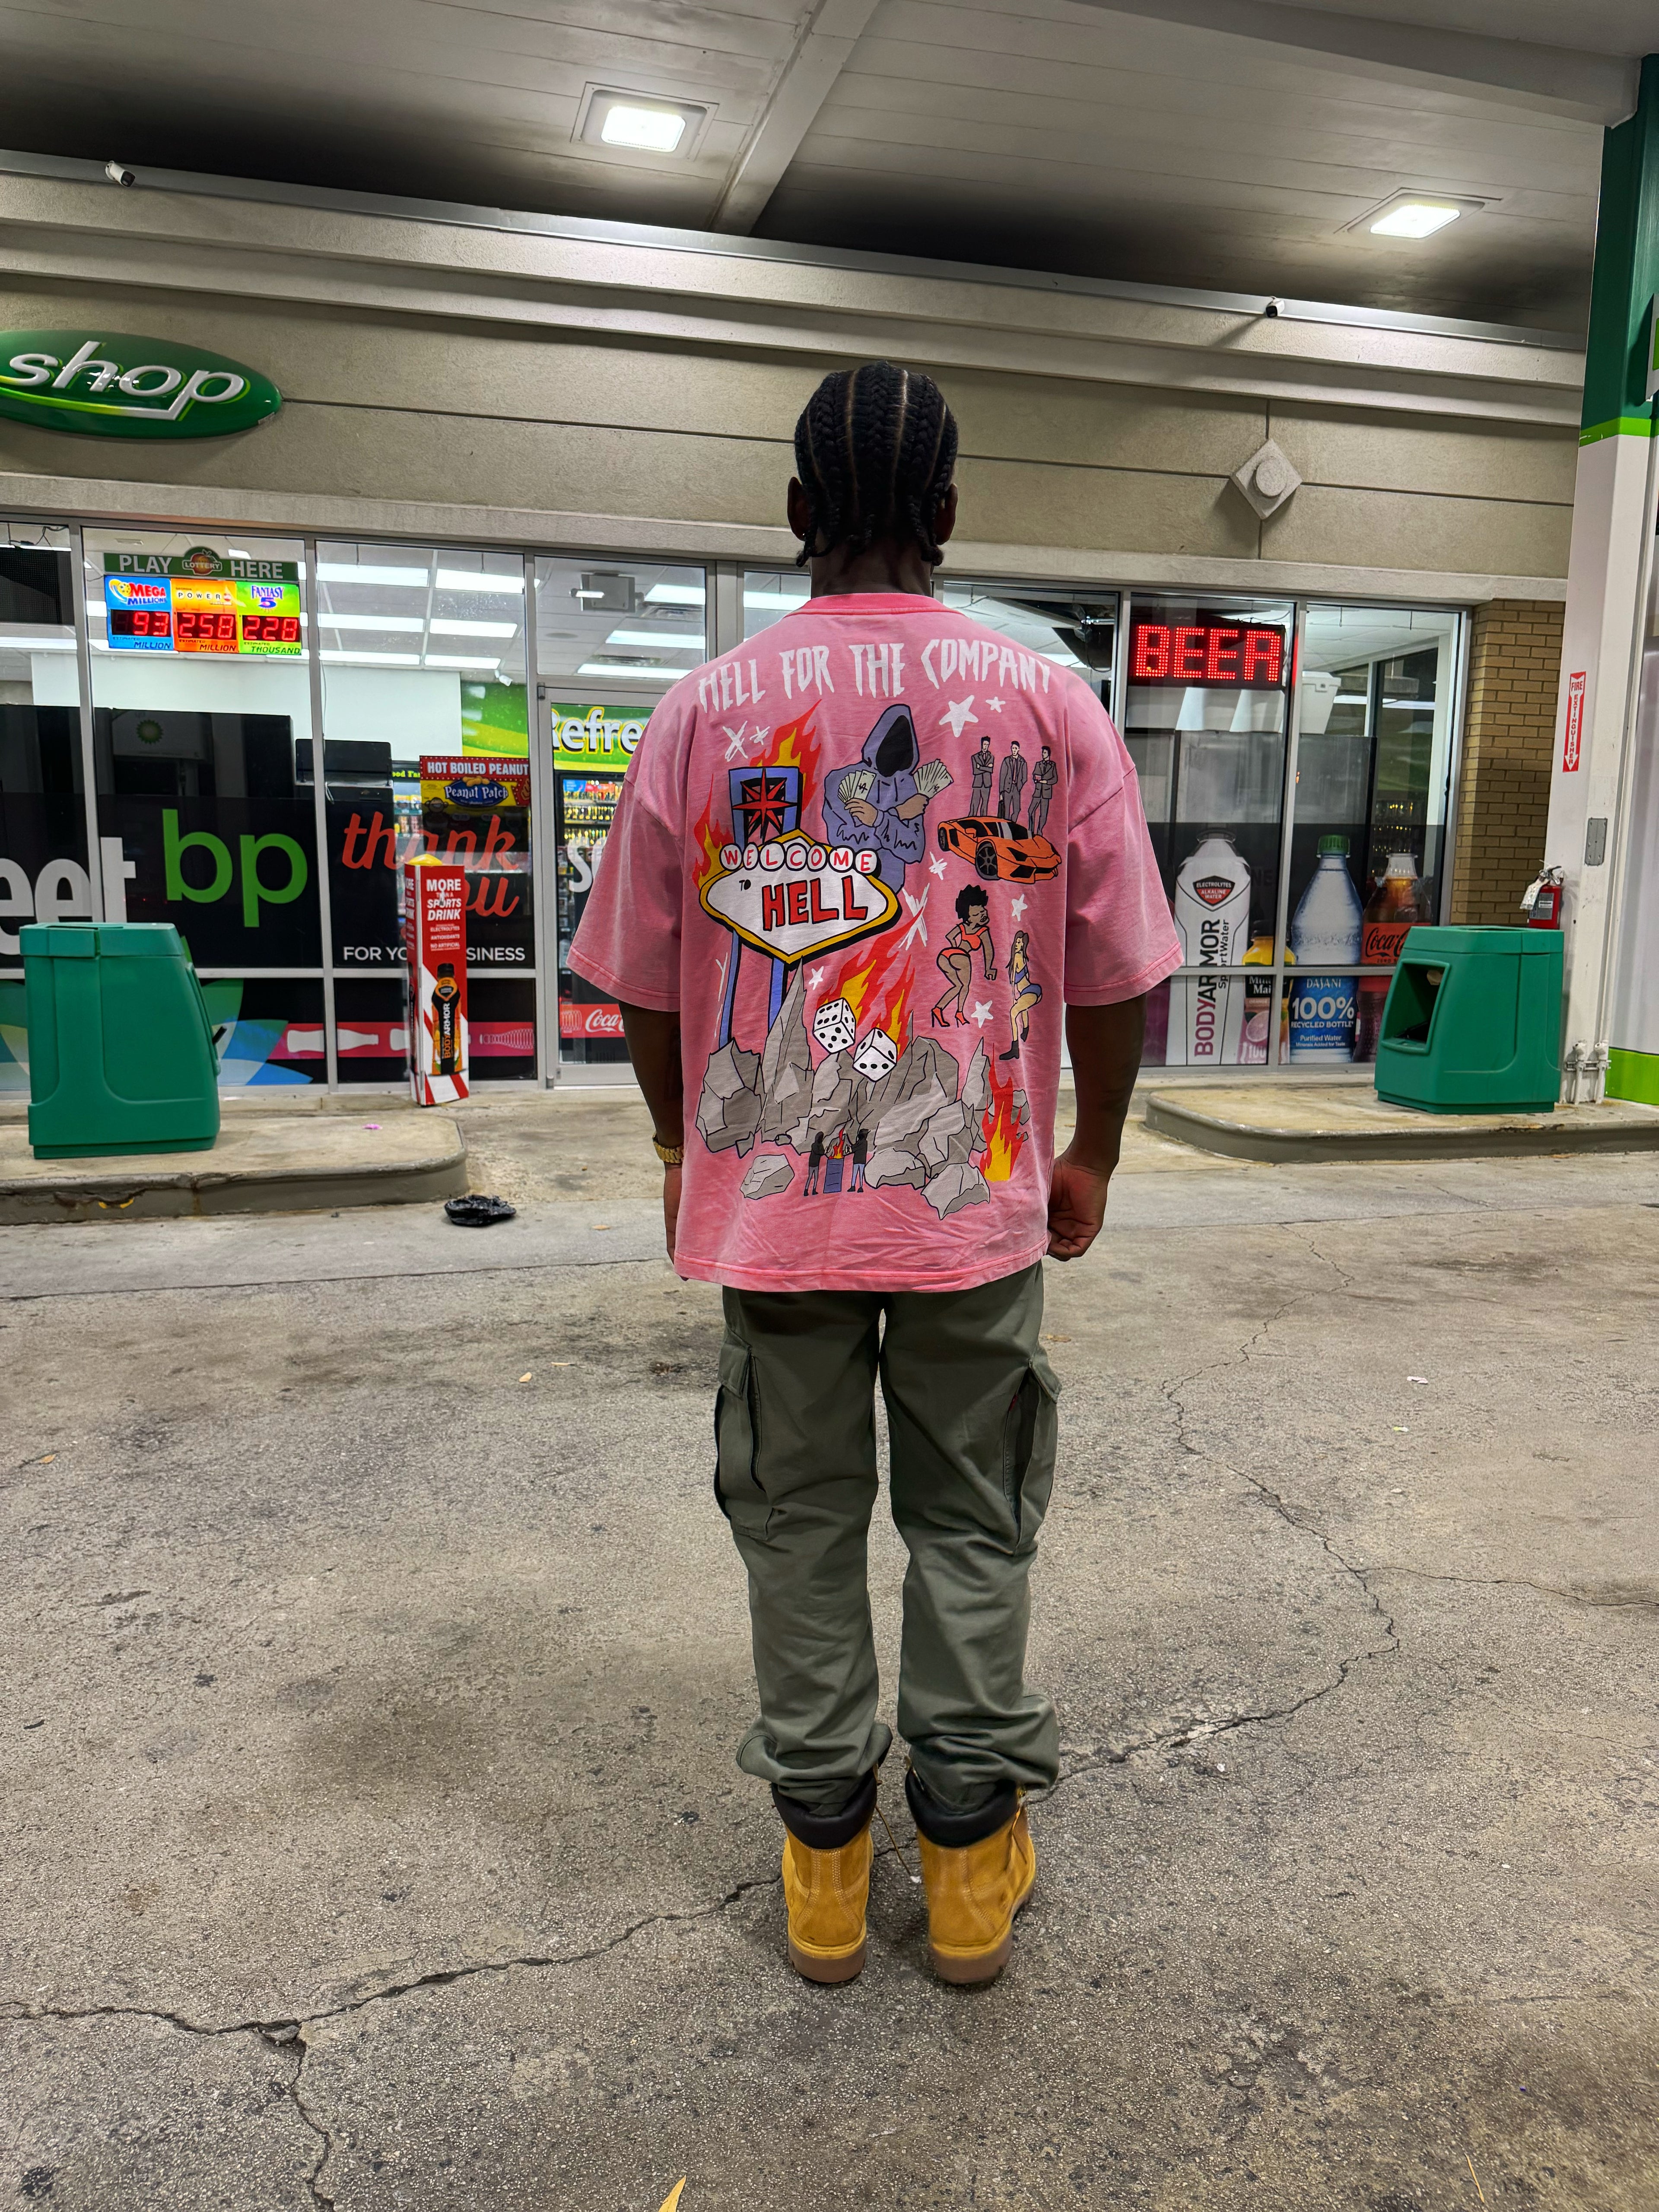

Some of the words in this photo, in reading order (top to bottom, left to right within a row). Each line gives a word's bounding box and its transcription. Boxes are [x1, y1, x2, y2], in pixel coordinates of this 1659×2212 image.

[10, 340, 245, 420] shop
[119, 554, 173, 574] PLAY
[231, 560, 283, 579] HERE
[129, 582, 166, 597] MEGA
[251, 585, 284, 600] FANTASY
[258, 597, 277, 608] 5
[133, 611, 169, 636] 93
[179, 613, 234, 638] 258
[243, 617, 298, 641] 228
[1135, 625, 1281, 682] BEER
[698, 658, 766, 714] HELL
[779, 645, 835, 699] FOR
[849, 642, 905, 699] THE
[920, 639, 1051, 694] COMPANY
[1571, 681, 1583, 692] FIRE
[1568, 694, 1578, 765] EXTINGUISHER
[427, 762, 448, 774] HOT
[450, 762, 486, 775] BOILED
[444, 785, 479, 799] Peanut
[482, 786, 509, 799] Patch
[342, 811, 519, 870] thank
[162, 809, 308, 928] bp
[723, 849, 872, 872] WELCOME
[426, 878, 461, 892] MORE
[739, 879, 752, 891] TO
[427, 908, 461, 921] DRINK
[762, 875, 868, 932] HELL
[343, 946, 381, 961] FOR
[466, 947, 525, 961] SINESS
[1194, 919, 1220, 1057] BODYARMOR
[1306, 977, 1341, 990] DASANI
[1292, 996, 1354, 1020] 100%
[443, 1002, 451, 1059] BODYARMOR
